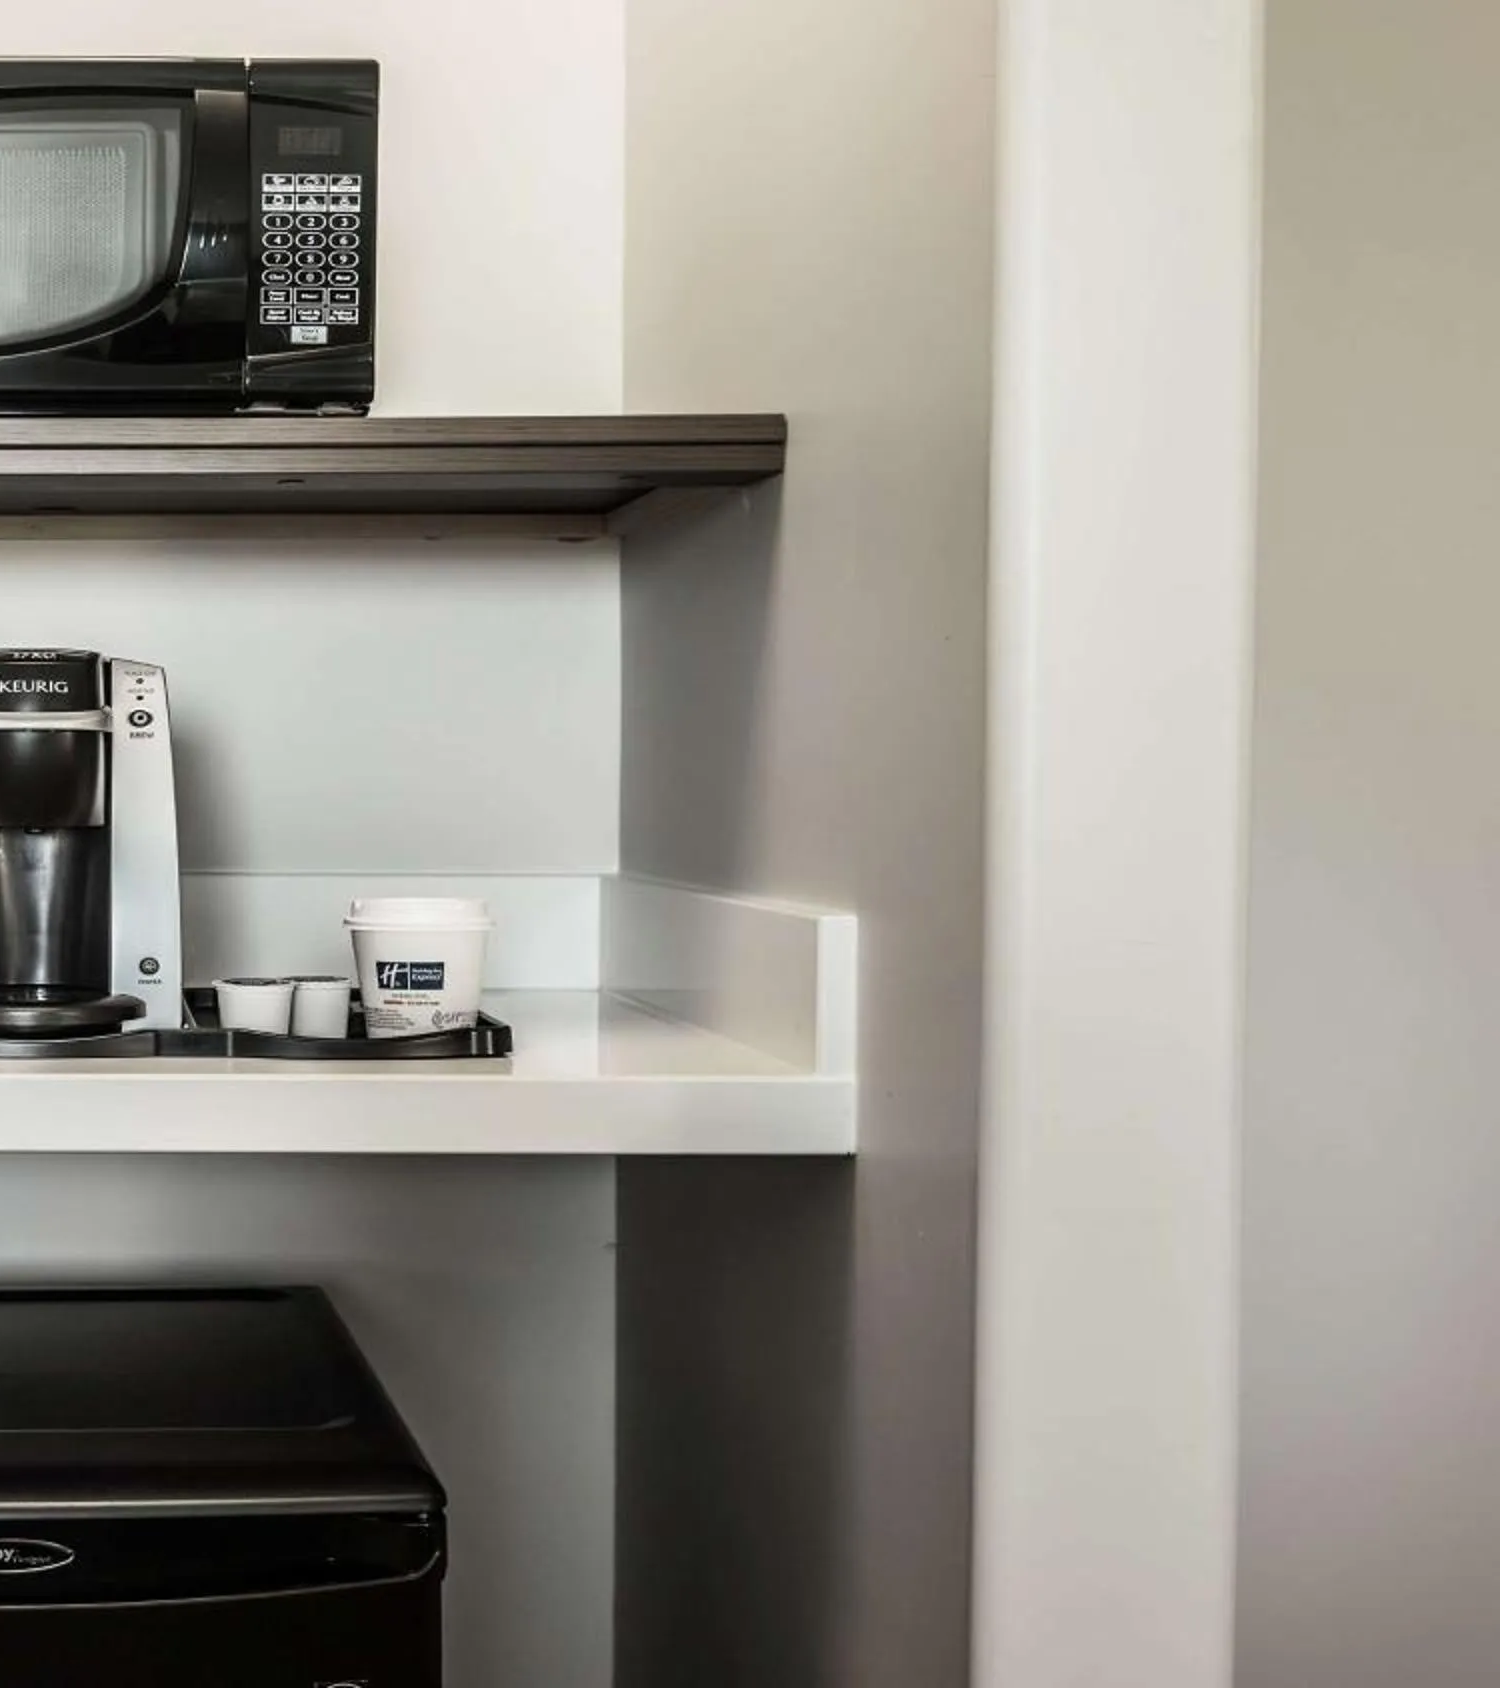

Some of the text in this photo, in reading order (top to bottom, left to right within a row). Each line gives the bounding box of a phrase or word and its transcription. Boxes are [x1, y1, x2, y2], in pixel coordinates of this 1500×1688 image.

[307, 217, 315, 227] 2
[340, 217, 349, 227] 3
[274, 235, 348, 245] 4 5 6
[274, 253, 348, 264] 7 8 9
[0, 679, 69, 693] KEURIG
